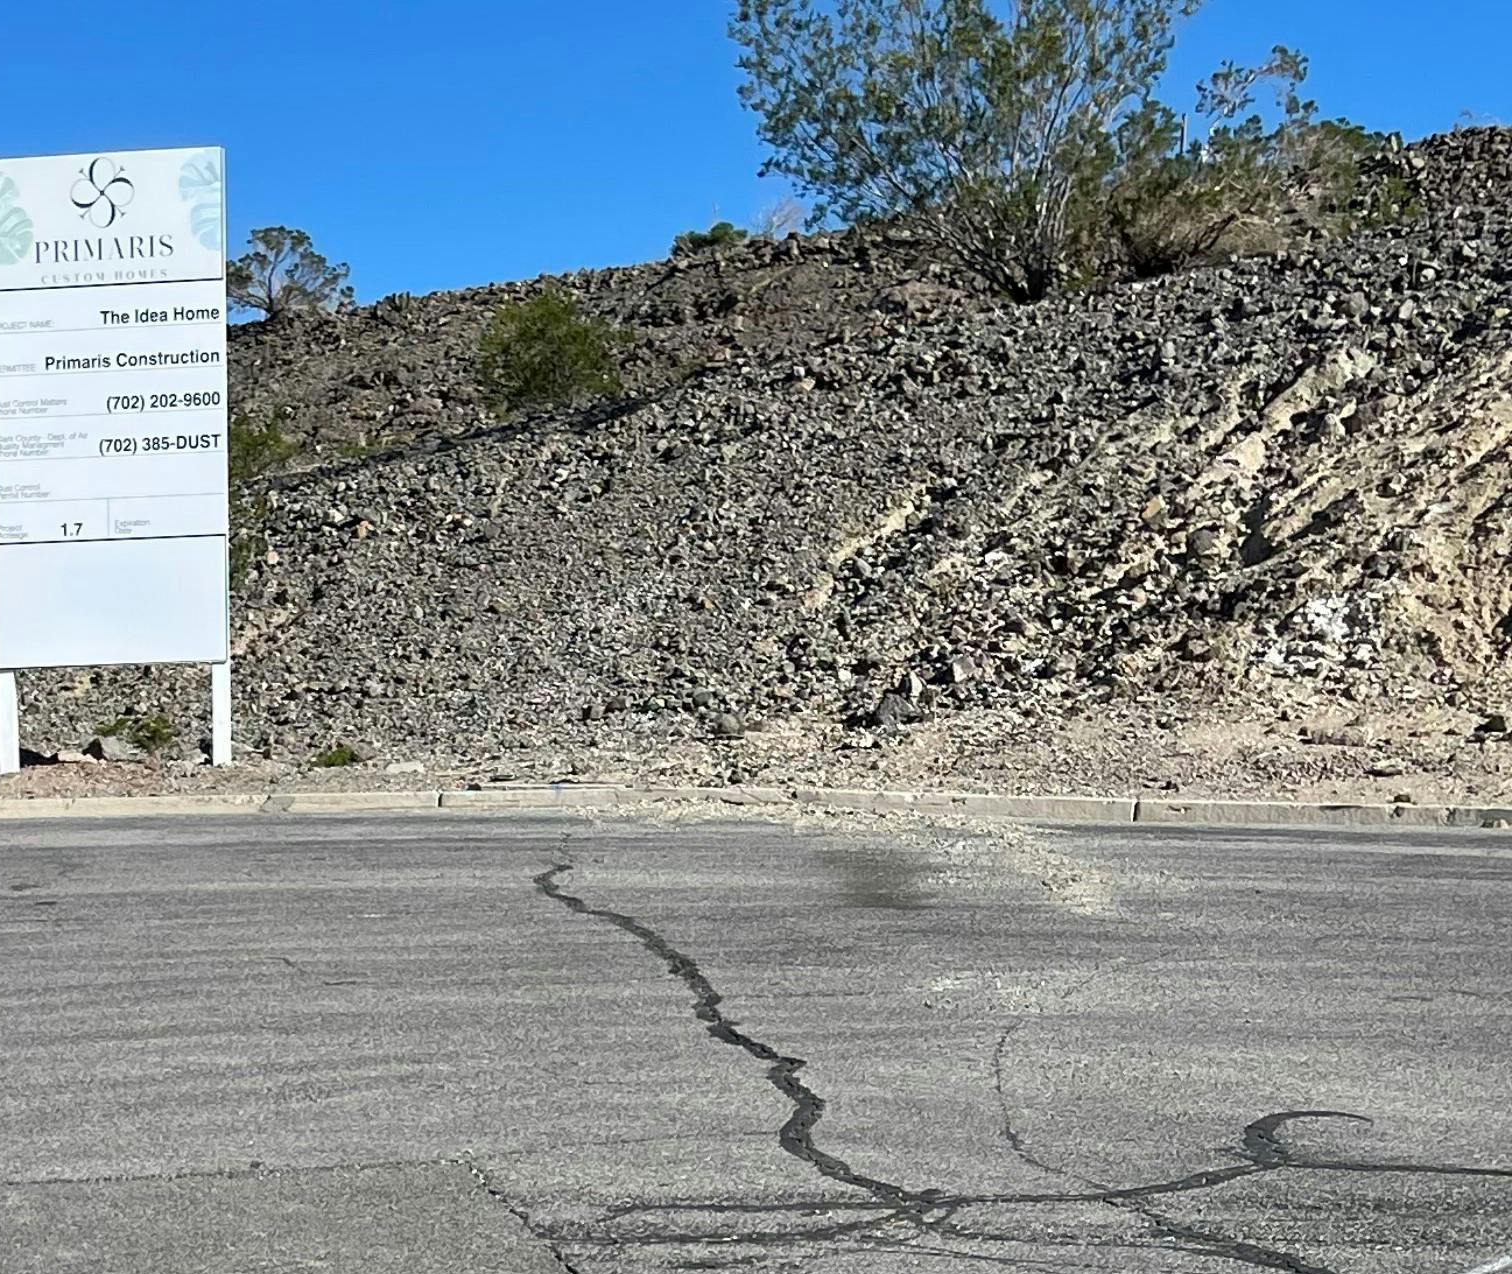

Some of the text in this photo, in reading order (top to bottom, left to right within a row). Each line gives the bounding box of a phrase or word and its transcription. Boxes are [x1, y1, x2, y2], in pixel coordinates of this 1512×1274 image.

[35, 233, 175, 264] PRIMARIS
[40, 268, 169, 285] CUSTOM HOMES
[99, 306, 220, 325] The Idea Home
[45, 349, 220, 371] Primaris Construction
[106, 391, 221, 414] (702) 202-9600
[98, 433, 221, 456] (702) 385-DUST
[60, 522, 83, 537] 1.7
